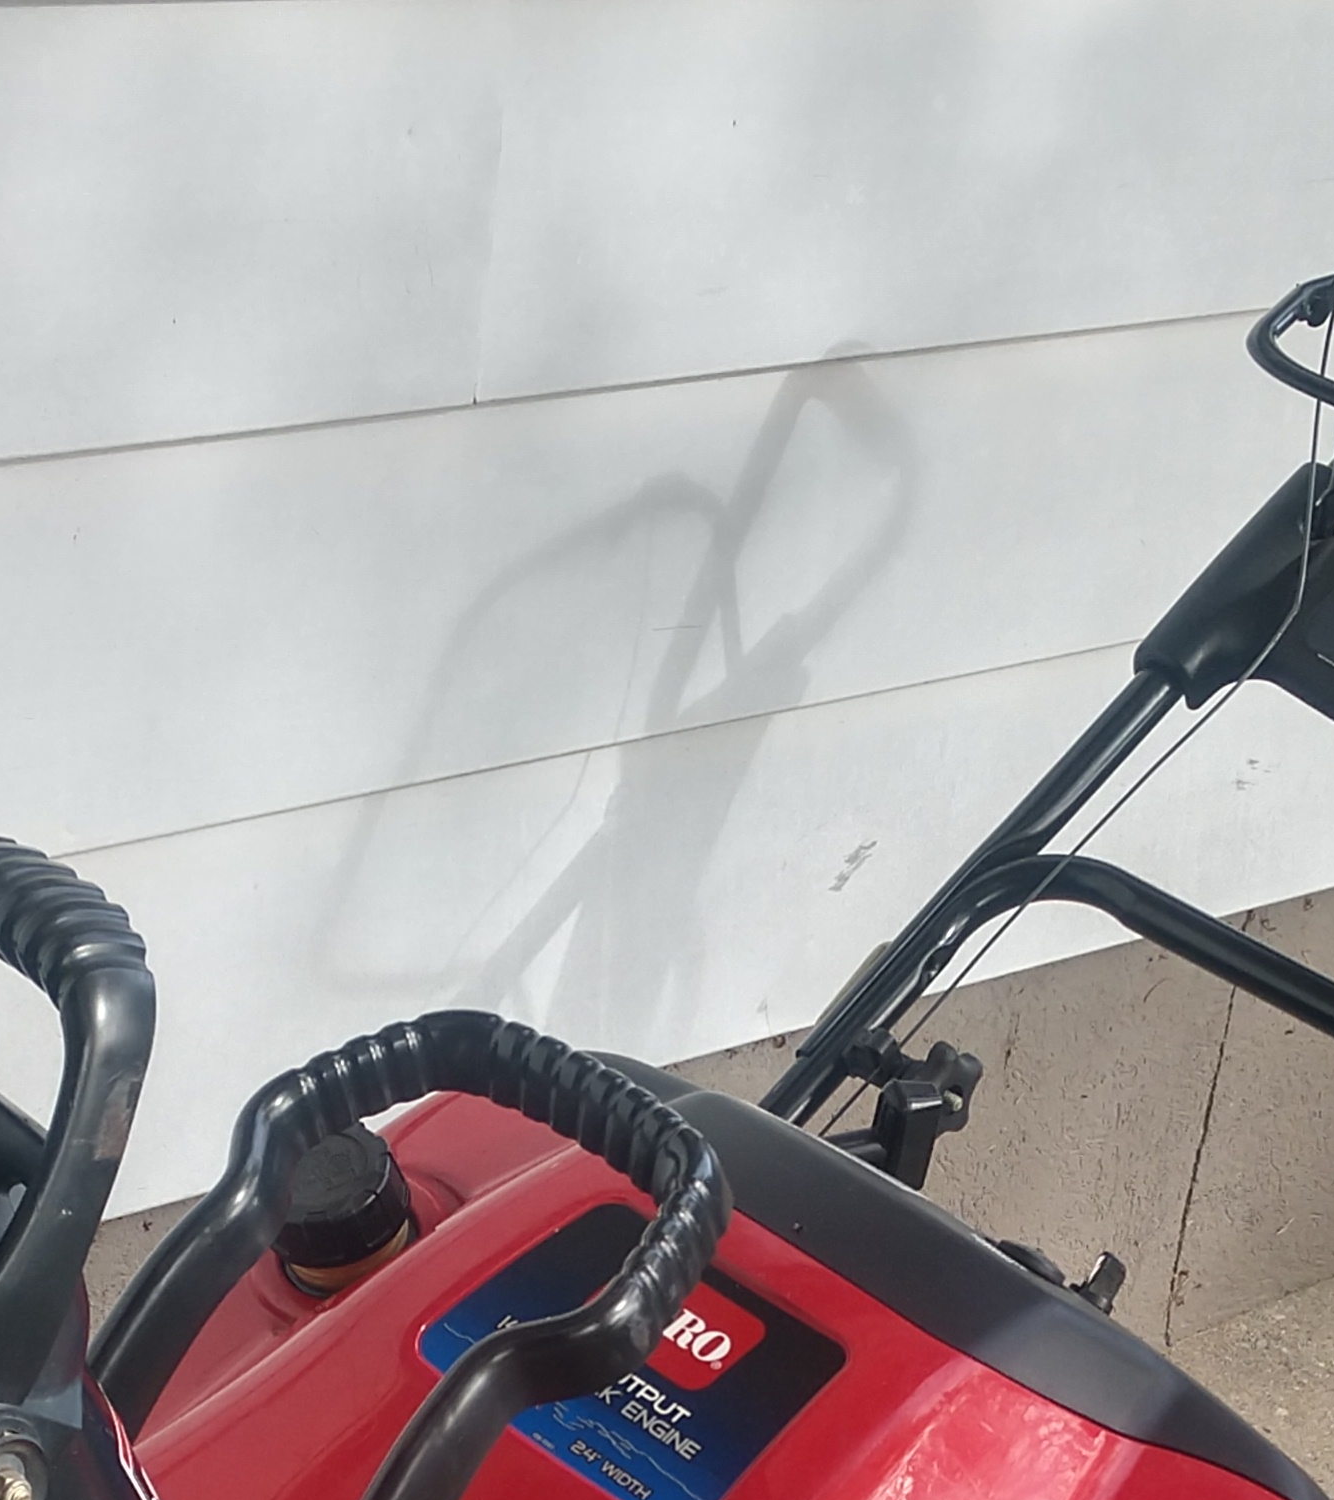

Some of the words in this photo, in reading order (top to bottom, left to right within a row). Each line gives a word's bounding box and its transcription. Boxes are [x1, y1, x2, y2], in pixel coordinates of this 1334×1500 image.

[662, 1307, 732, 1362] RO
[618, 1373, 692, 1424] TPUT
[620, 1400, 703, 1461] ENGINE
[601, 1460, 653, 1500] WIDTH
